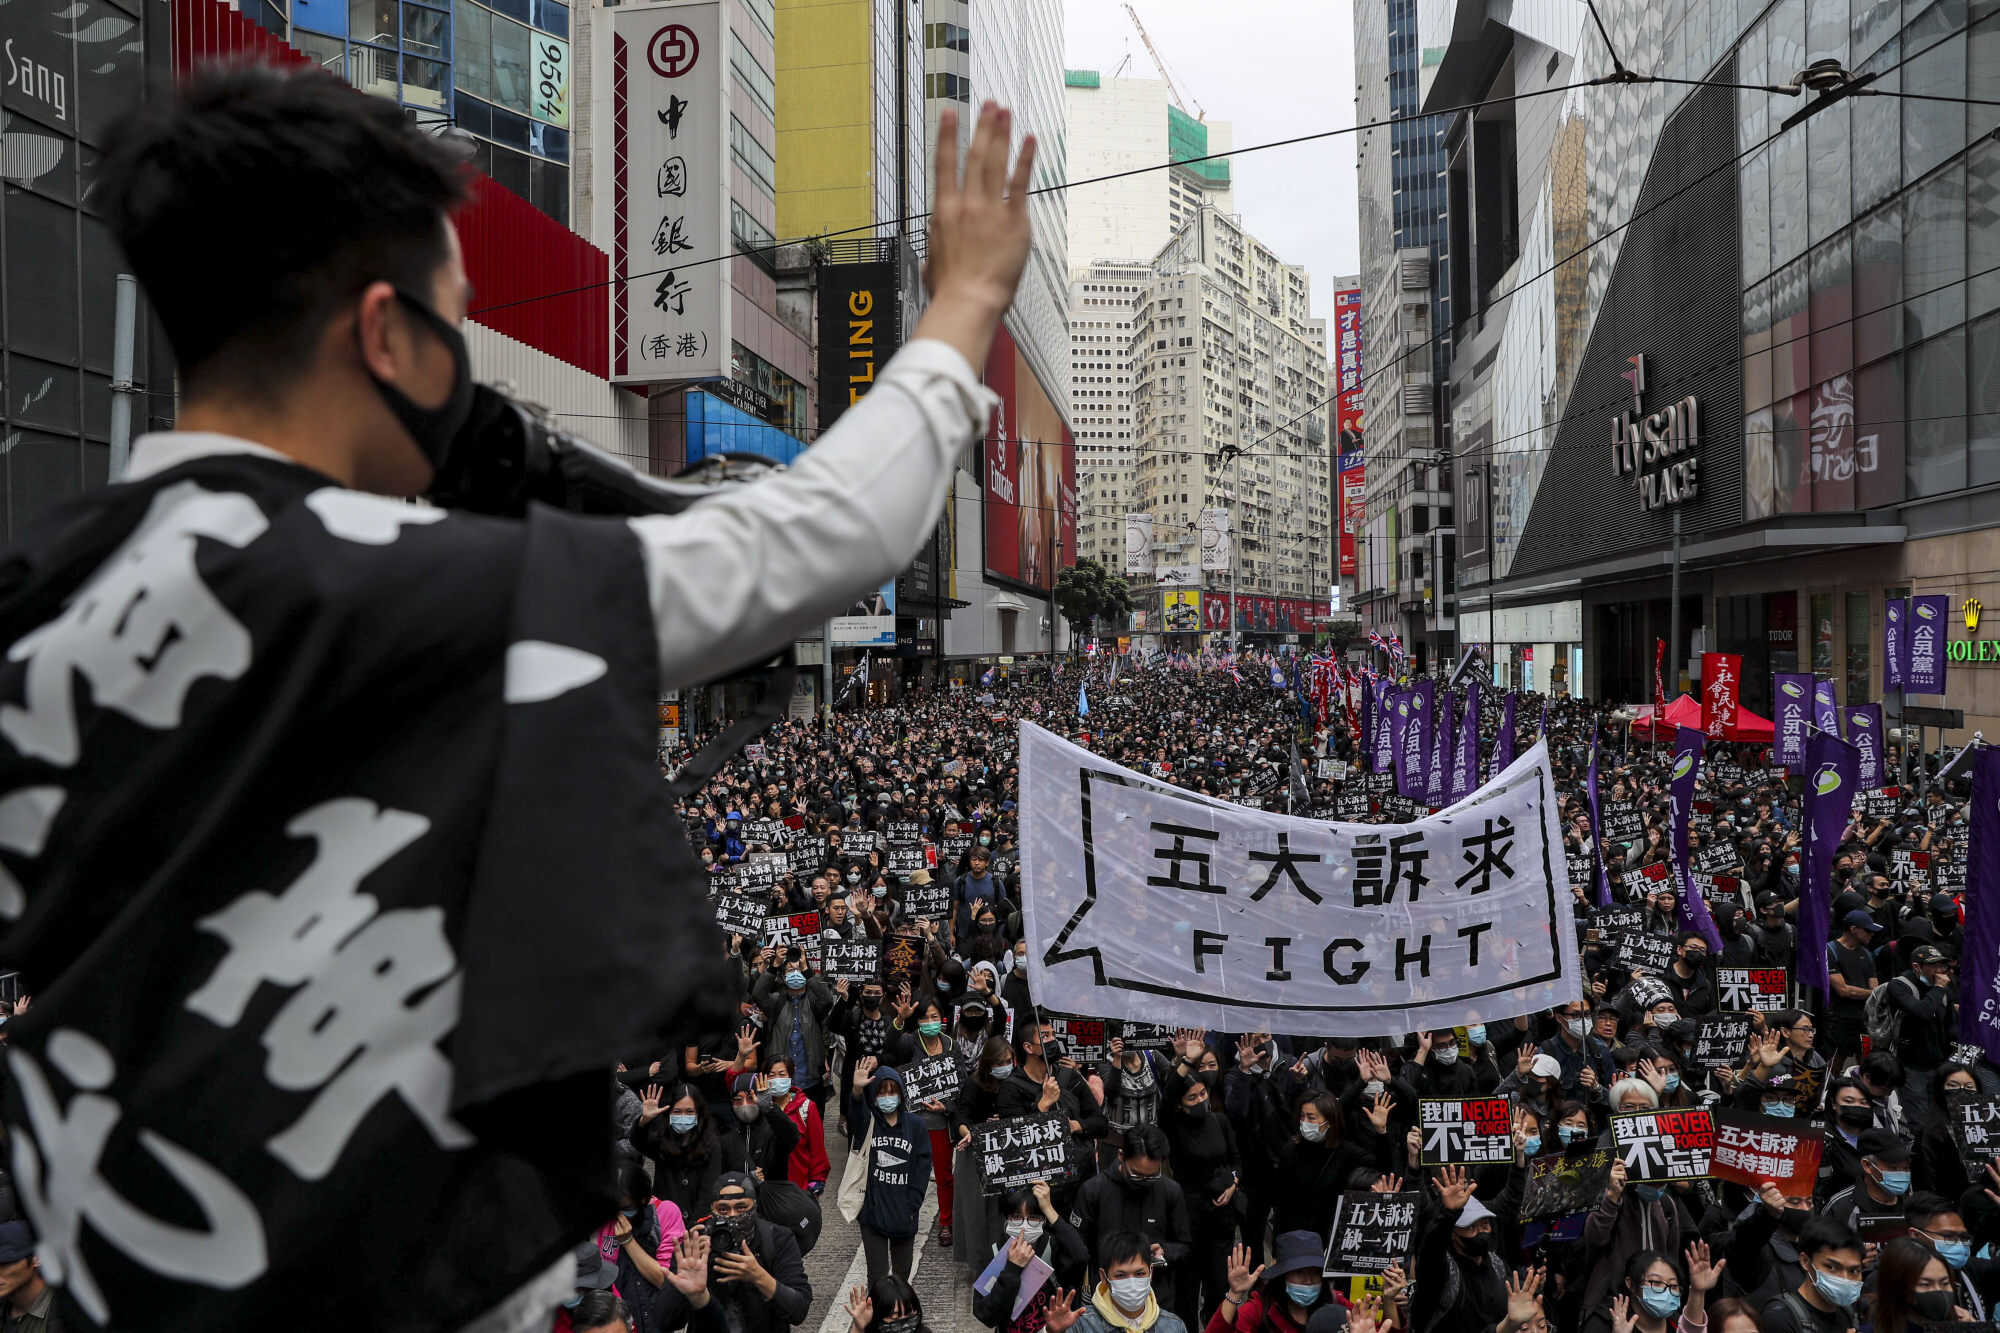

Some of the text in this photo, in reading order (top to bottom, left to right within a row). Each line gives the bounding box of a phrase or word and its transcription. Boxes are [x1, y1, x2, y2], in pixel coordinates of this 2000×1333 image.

[5, 38, 66, 121] Sang
[538, 42, 562, 126] 9564
[652, 94, 695, 316] 中國銀行
[640, 331, 708, 360] (香港)
[1610, 395, 1699, 488] Hysan
[991, 458, 1014, 504] Emirates
[1639, 458, 1698, 512] PLACE
[1768, 630, 1793, 641] TUDOR
[1604, 812, 1640, 828] 五大訴求
[844, 834, 874, 843] 五大訴求
[889, 850, 923, 861] 五大訴求
[1147, 817, 1516, 908] 五大訴求
[1699, 843, 1734, 861] 五大訴求
[740, 863, 772, 877] 五大訴求
[719, 895, 767, 916] 五大訴求
[904, 899, 950, 914] 缺一不可
[905, 887, 950, 901] 五大訴求
[716, 907, 763, 930] 缺一不可
[765, 916, 790, 932] 我們
[1595, 911, 1643, 928] 五大訴求
[825, 944, 878, 959] 五大訴求
[1193, 921, 1493, 986] FIGHT
[1623, 932, 1673, 954] 五大訴求
[825, 957, 877, 973] 缺一不可
[1618, 946, 1671, 969] 缺一不可
[1718, 969, 1785, 984] 我們 NEVER
[1719, 983, 1751, 1011] 不
[1750, 993, 1786, 1011] 忘記
[1067, 1021, 1104, 1036] NEVER
[1698, 1021, 1749, 1039] 五大訴求
[1696, 1038, 1746, 1056] 缺一不可
[903, 1056, 956, 1085] 五大訴求
[906, 1070, 960, 1100] 缺一不可
[1421, 1099, 1509, 1123] 我們 NEVER
[979, 1120, 1063, 1153] 五大訴求
[1613, 1112, 1713, 1139] 我們 NEVER
[1423, 1120, 1510, 1163] 不 會 FORGET
[1464, 1135, 1512, 1161] 忘記
[1716, 1124, 1798, 1155] 五大訴求
[982, 1142, 1066, 1176] 缺一不可
[1618, 1131, 1714, 1180] 不 會 FORGET
[1664, 1148, 1711, 1178] 忘記
[1714, 1145, 1795, 1178] 堅持到底
[1346, 1202, 1415, 1227] 五大訴求
[1340, 1227, 1412, 1254] 缺一不可
